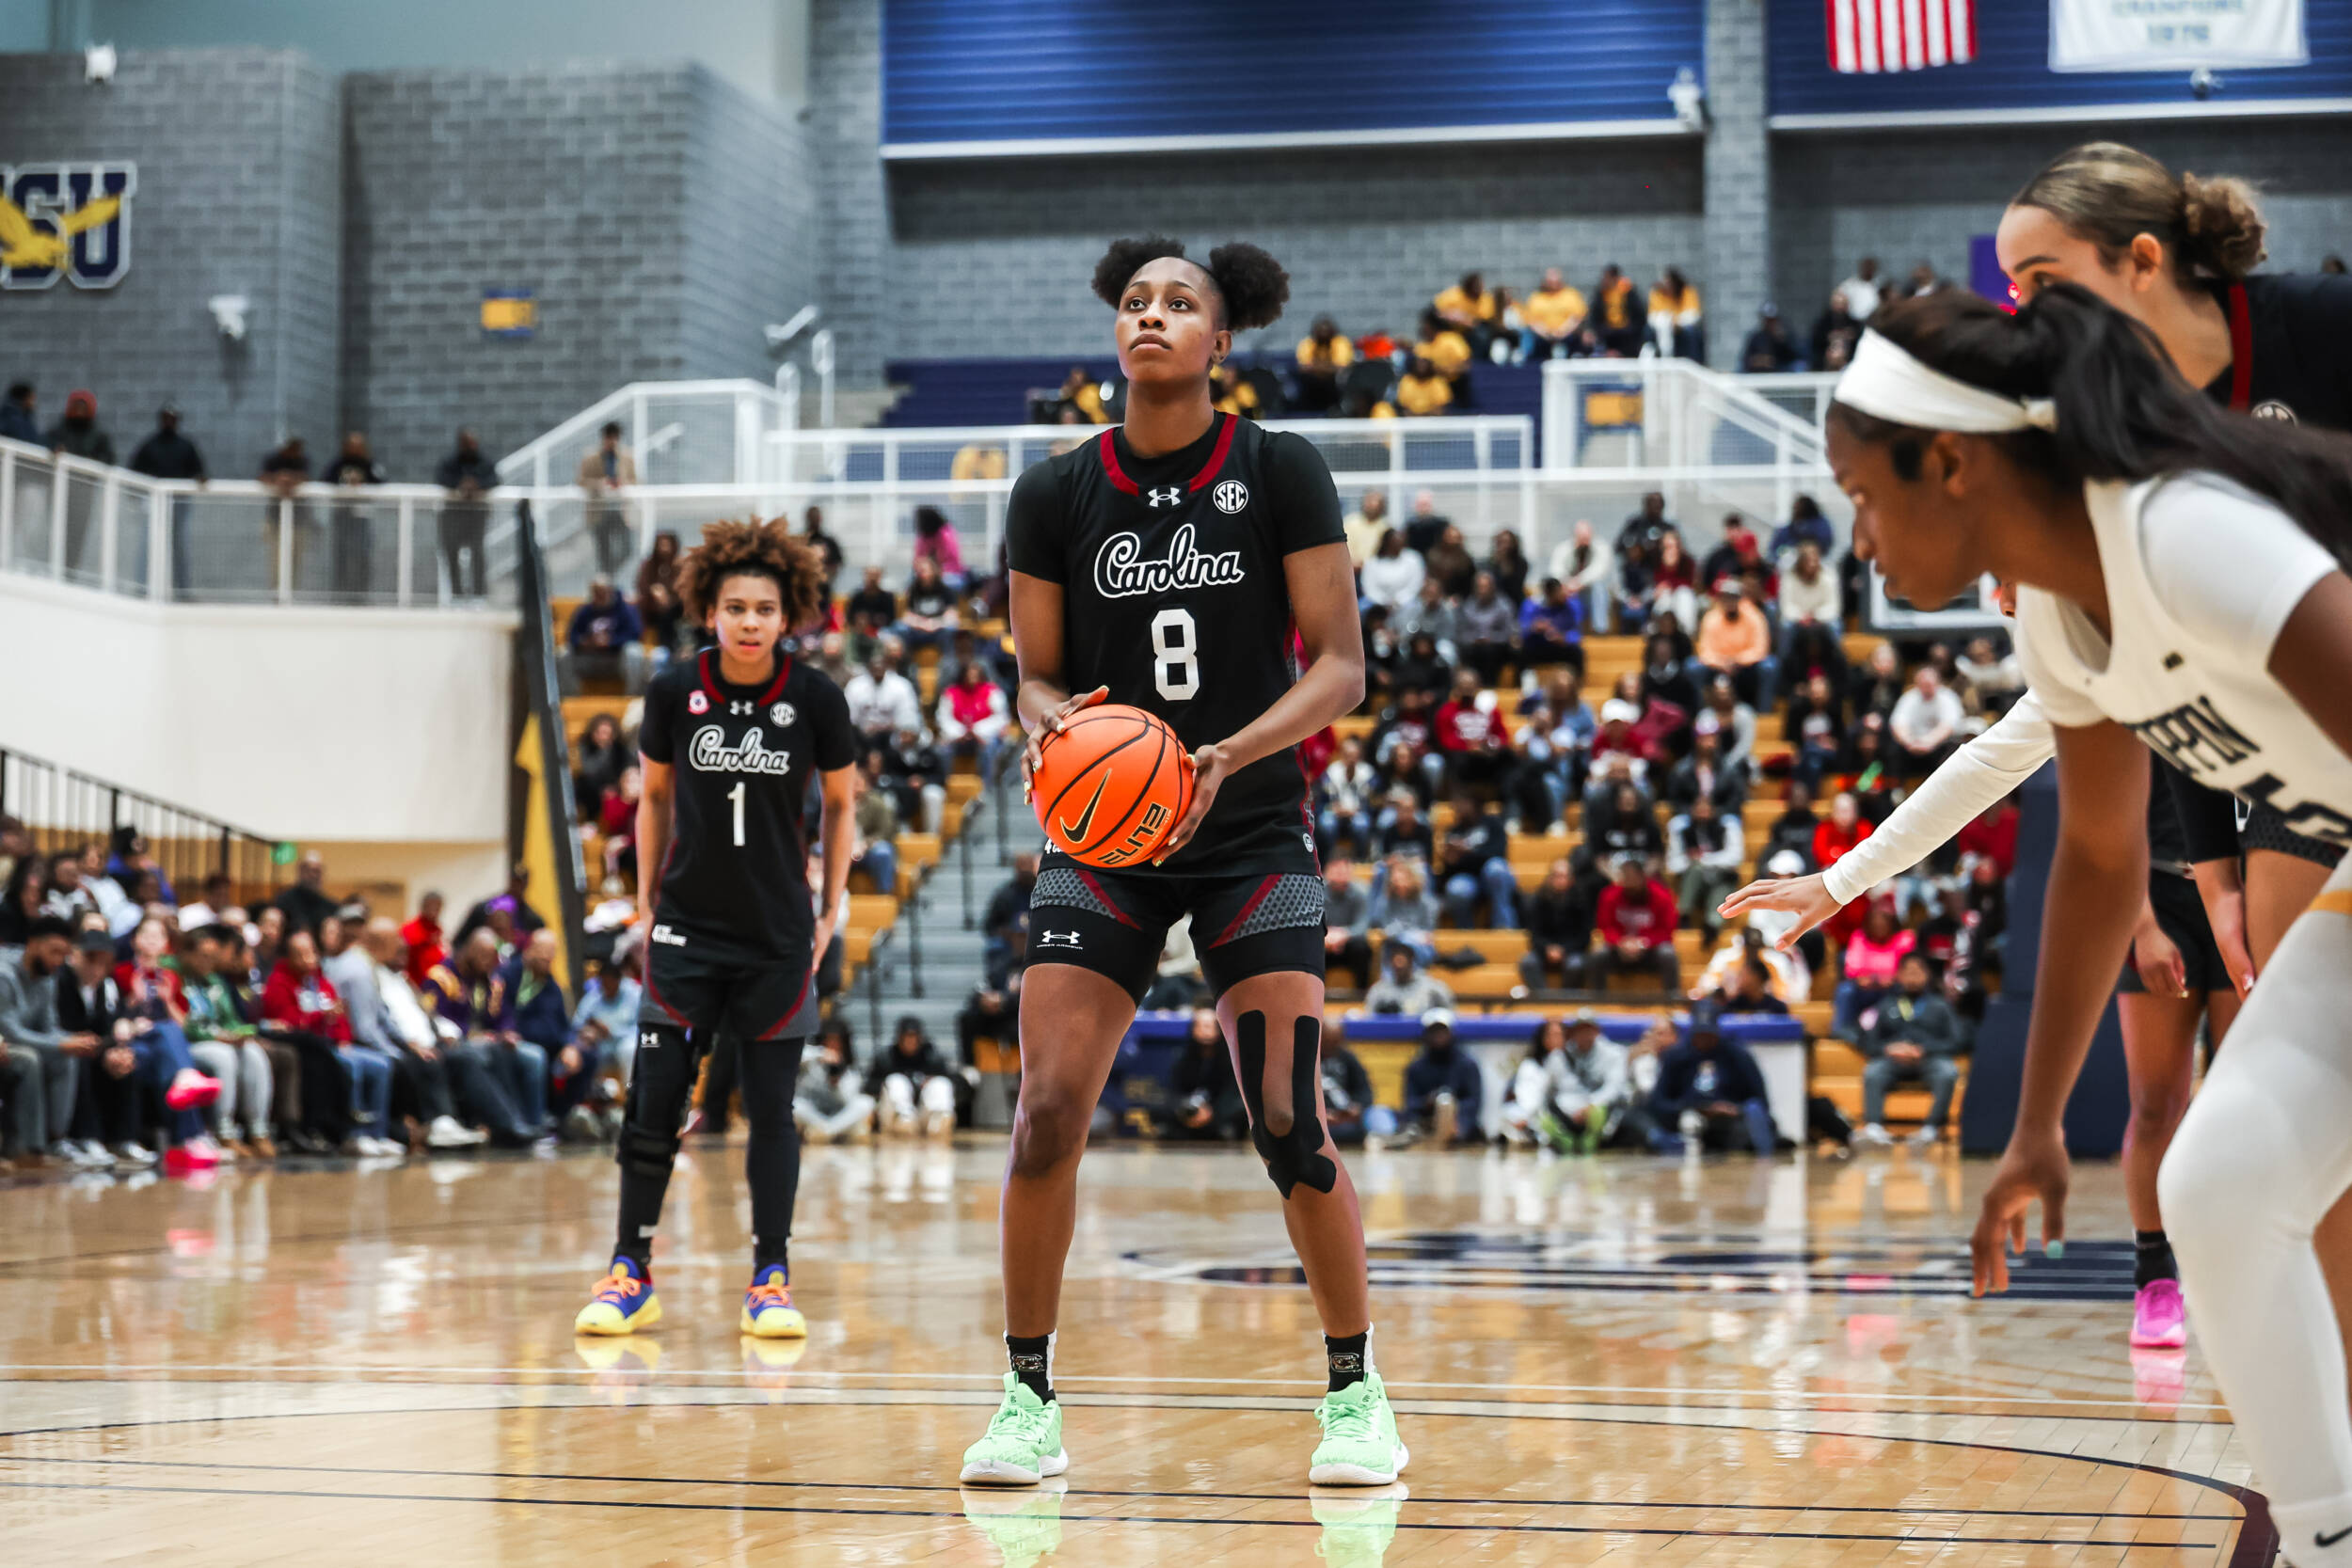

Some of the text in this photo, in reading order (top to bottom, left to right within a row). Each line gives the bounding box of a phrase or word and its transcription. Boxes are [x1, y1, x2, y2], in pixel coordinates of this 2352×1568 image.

[0, 159, 137, 290] SU
[1216, 483, 1245, 511] SEC
[1094, 523, 1245, 598] Carolina
[1151, 609, 1200, 701] 8
[690, 724, 790, 775] Carolina
[2124, 694, 2261, 777] PPIN
[727, 782, 745, 847] 1
[1097, 801, 1168, 865] ELITE
